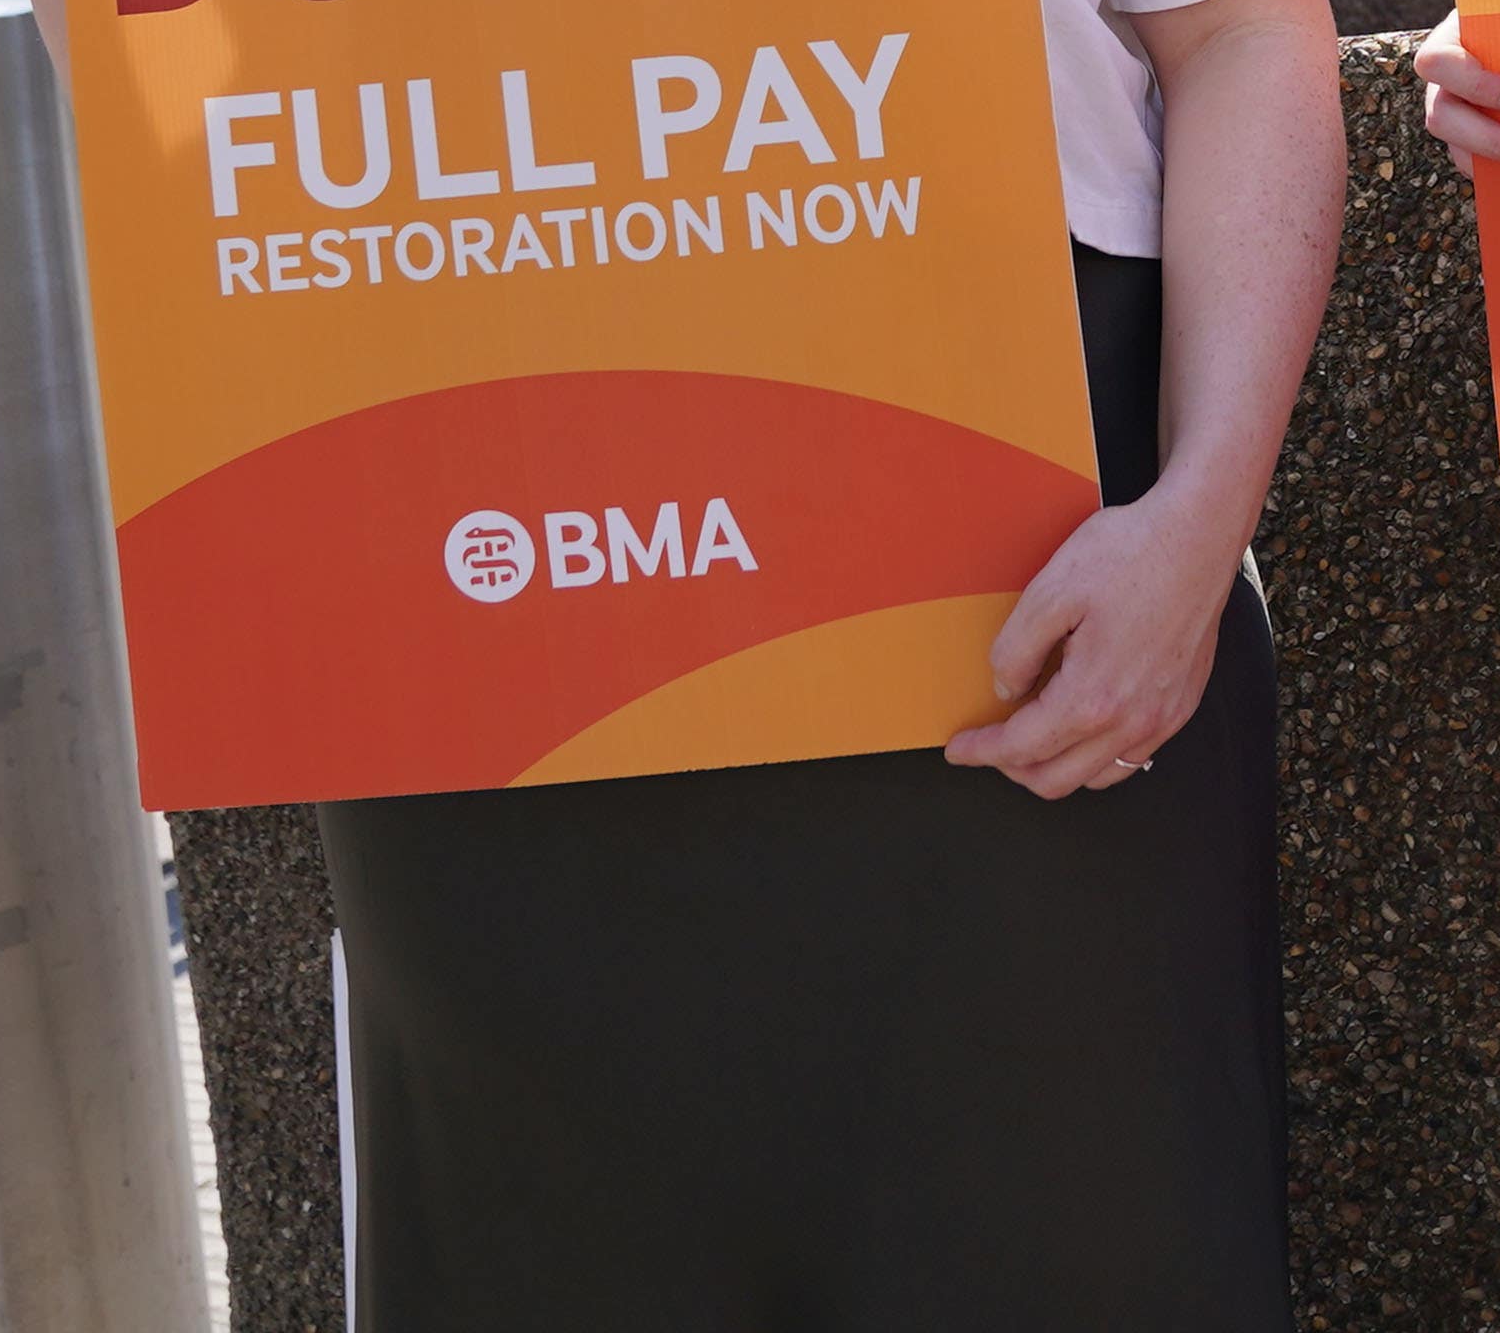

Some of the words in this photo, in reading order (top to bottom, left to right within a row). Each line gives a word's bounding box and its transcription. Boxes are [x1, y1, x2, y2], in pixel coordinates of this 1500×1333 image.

[204, 70, 596, 219] FULL
[634, 33, 912, 178] PAY
[217, 195, 725, 295] RESTORATION
[746, 177, 923, 251] NOW
[550, 498, 758, 588] BMA
